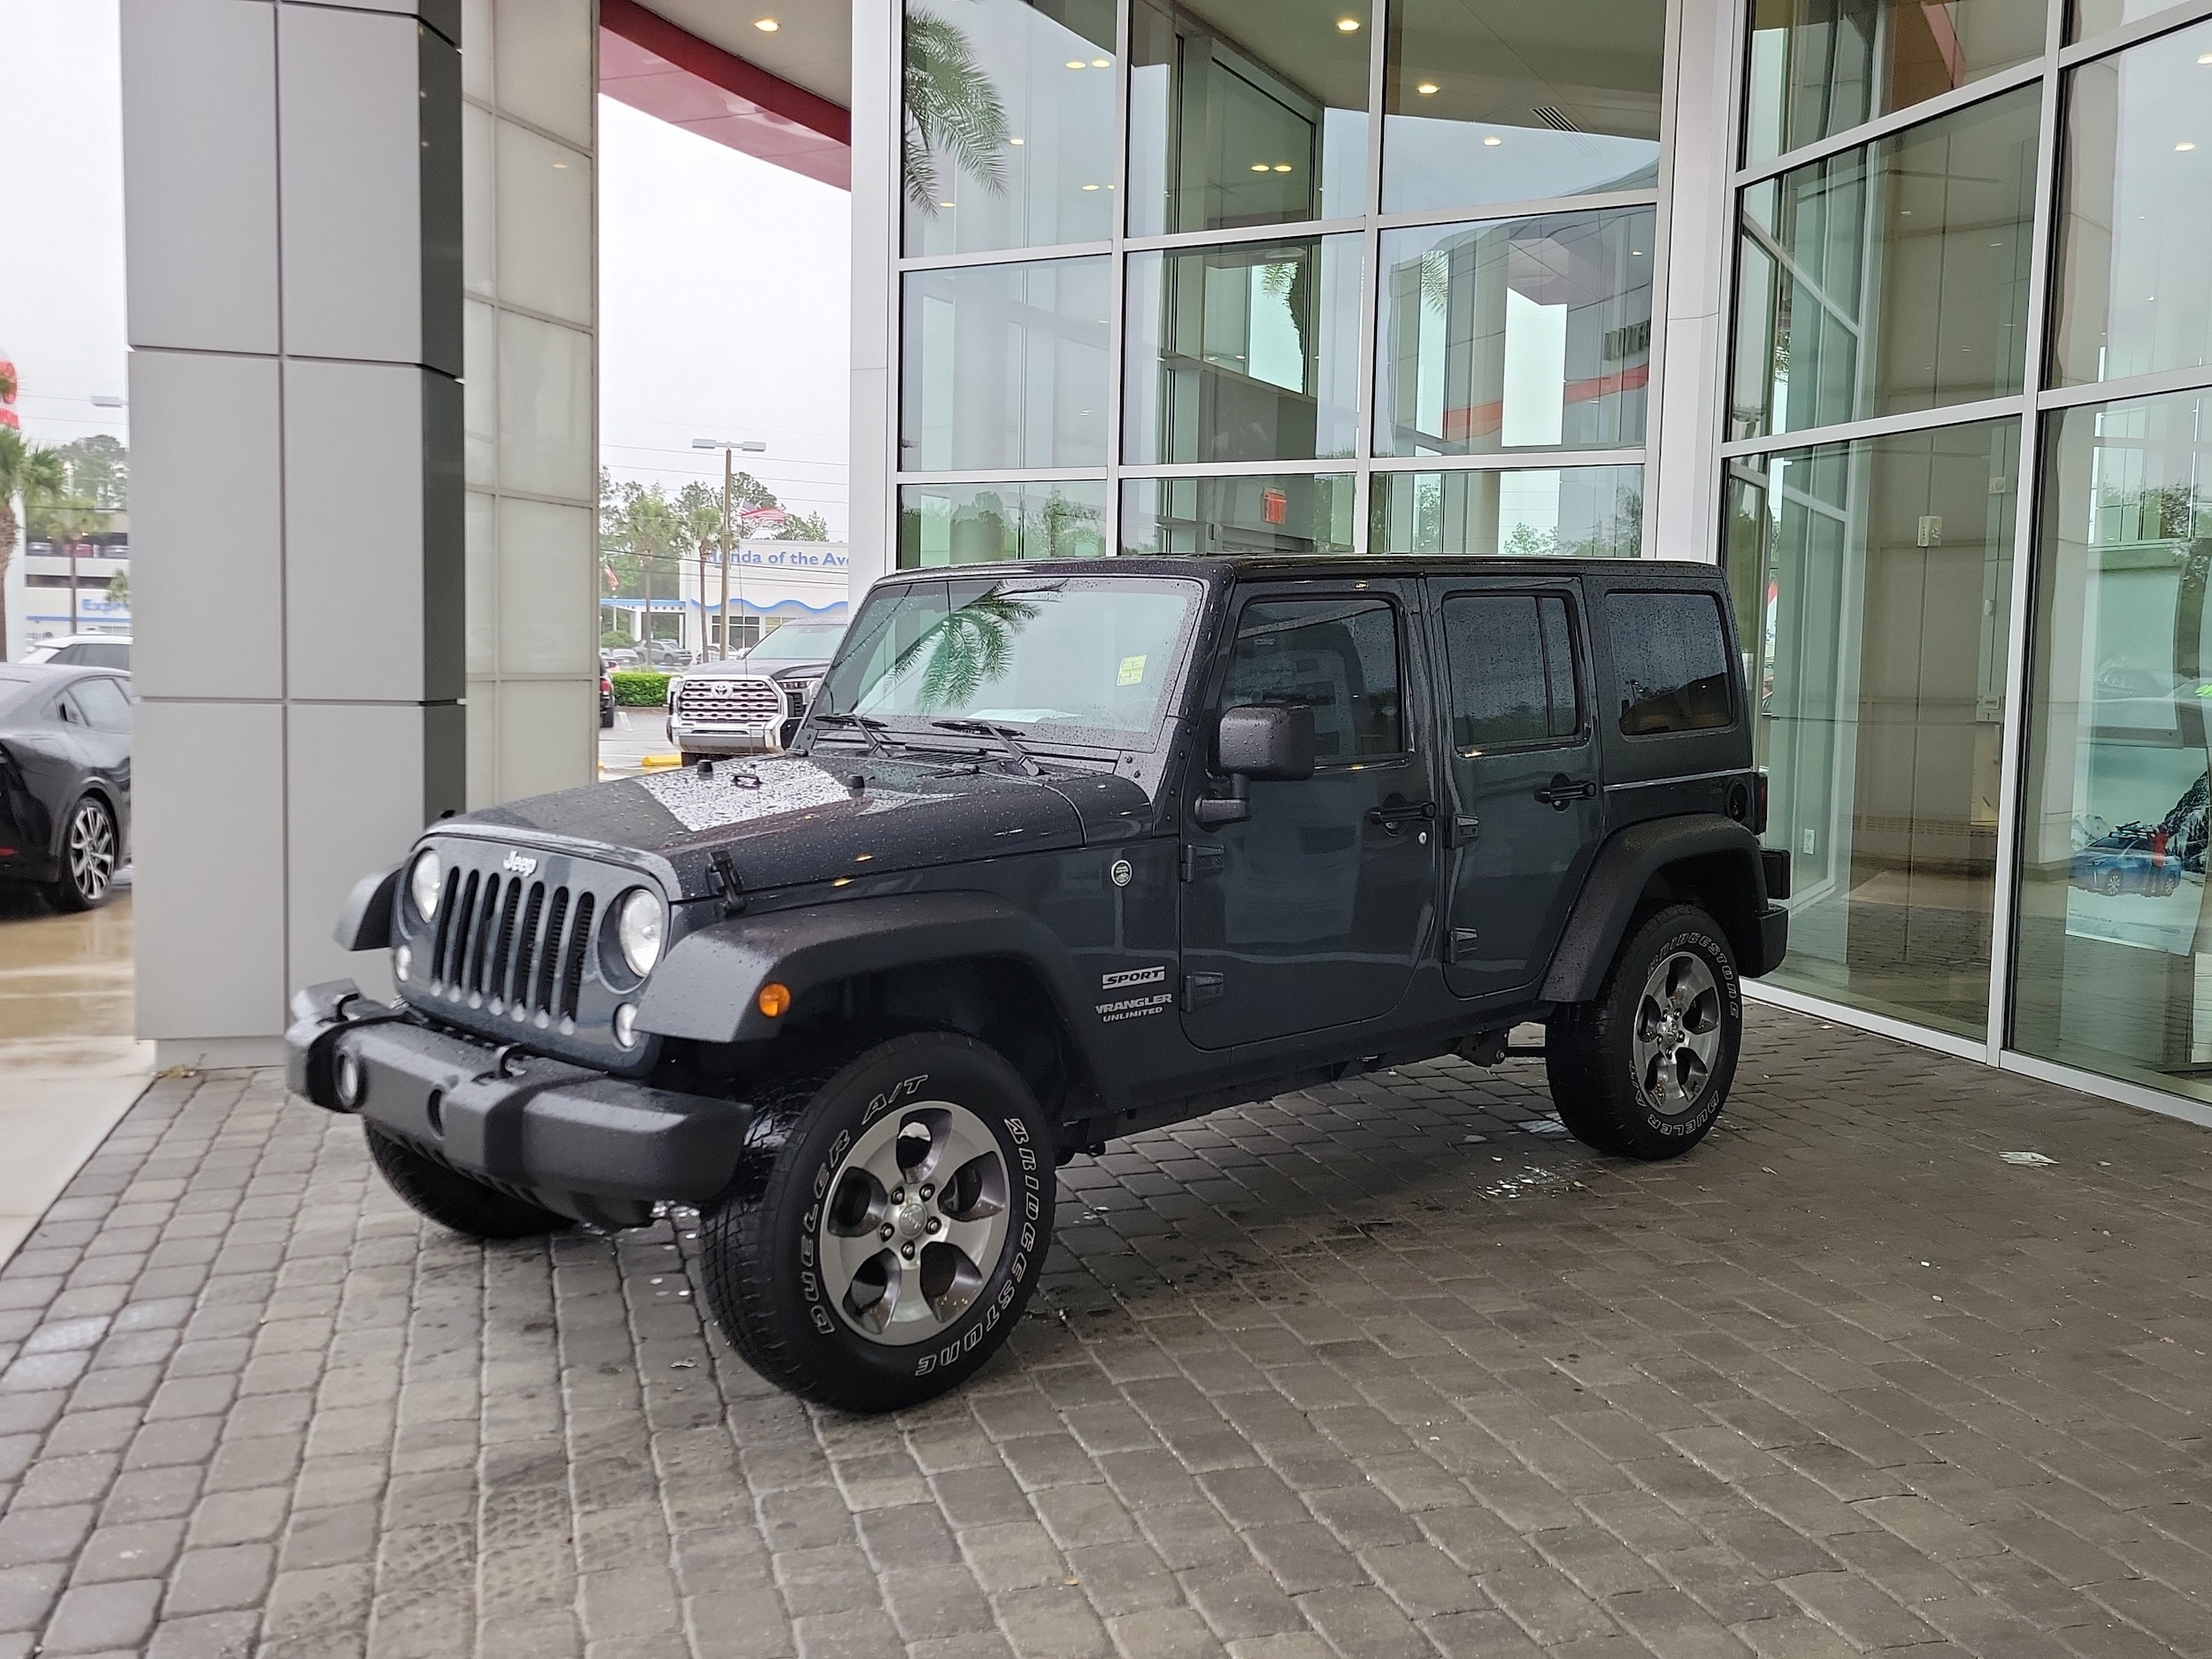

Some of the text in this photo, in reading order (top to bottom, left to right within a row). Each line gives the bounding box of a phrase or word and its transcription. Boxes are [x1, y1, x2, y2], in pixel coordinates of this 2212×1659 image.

[768, 551, 787, 564] of
[790, 552, 818, 565] the
[822, 552, 849, 565] Av
[503, 850, 538, 878] Jeep
[1106, 970, 1162, 985] SPORT
[1094, 993, 1173, 1014] WRANGLER
[1102, 1006, 1164, 1023] UNLIMITED
[1647, 1089, 1720, 1136] DUELER
[800, 1073, 929, 1334] DUELER A/T
[915, 1118, 1040, 1377] BRIDGESTONE
